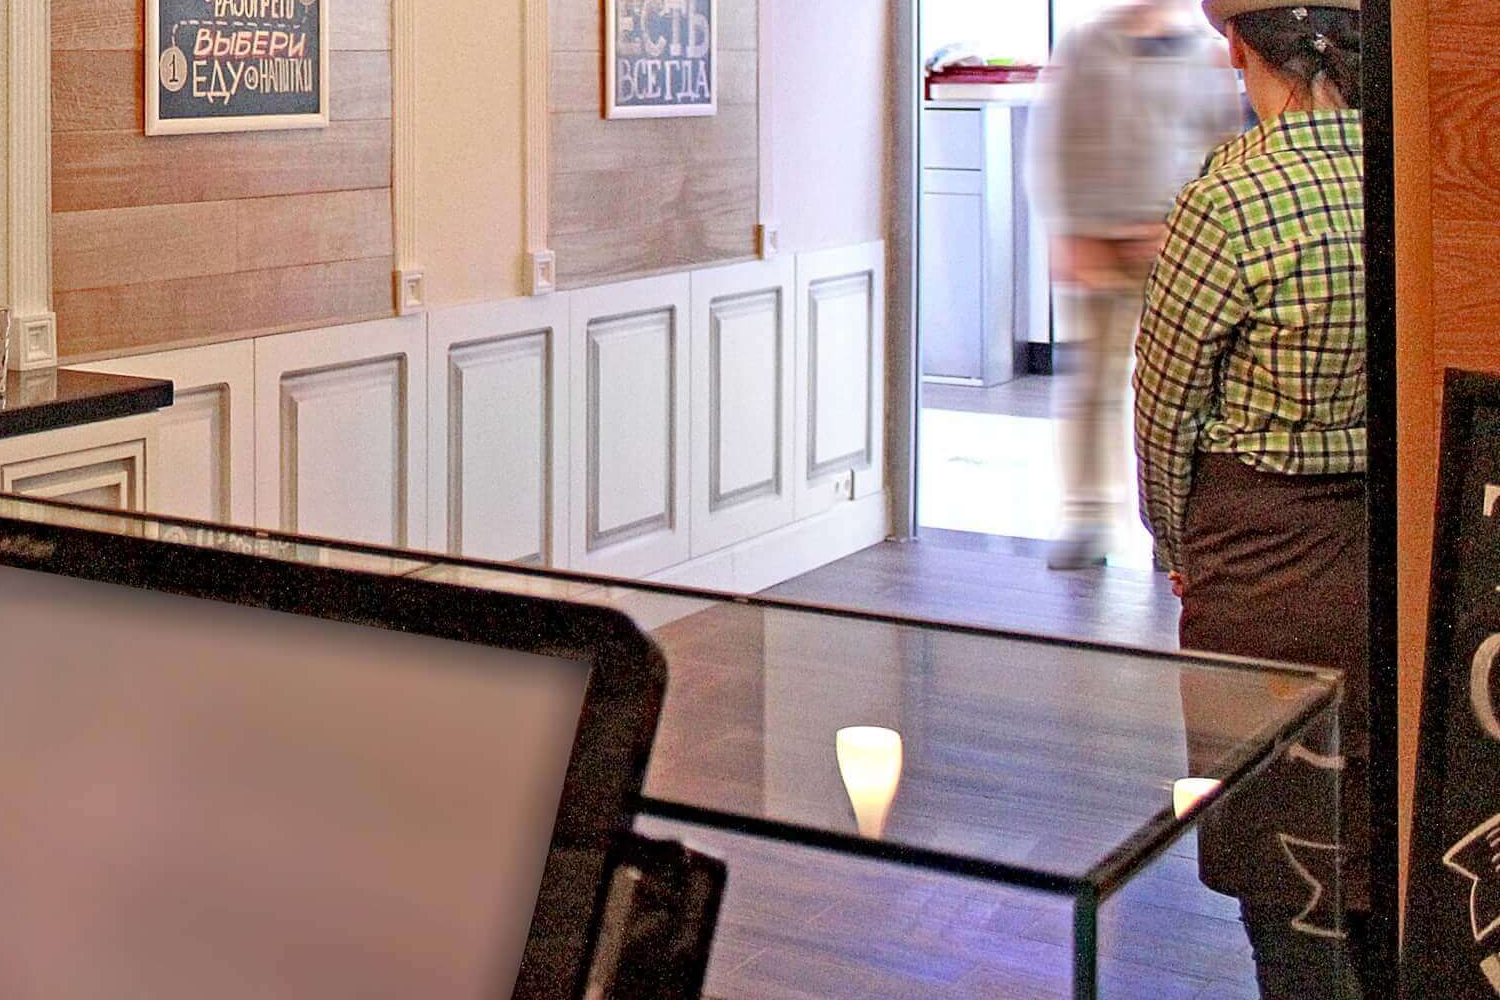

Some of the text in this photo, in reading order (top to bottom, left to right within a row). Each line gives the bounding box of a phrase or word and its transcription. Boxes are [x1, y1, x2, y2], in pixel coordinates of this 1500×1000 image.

[193, 28, 308, 58] ВЫБЕРИ
[192, 60, 245, 105] ЕДУ
[259, 57, 313, 94] НАПИТКИ
[617, 57, 710, 103] ВСЕГДА
